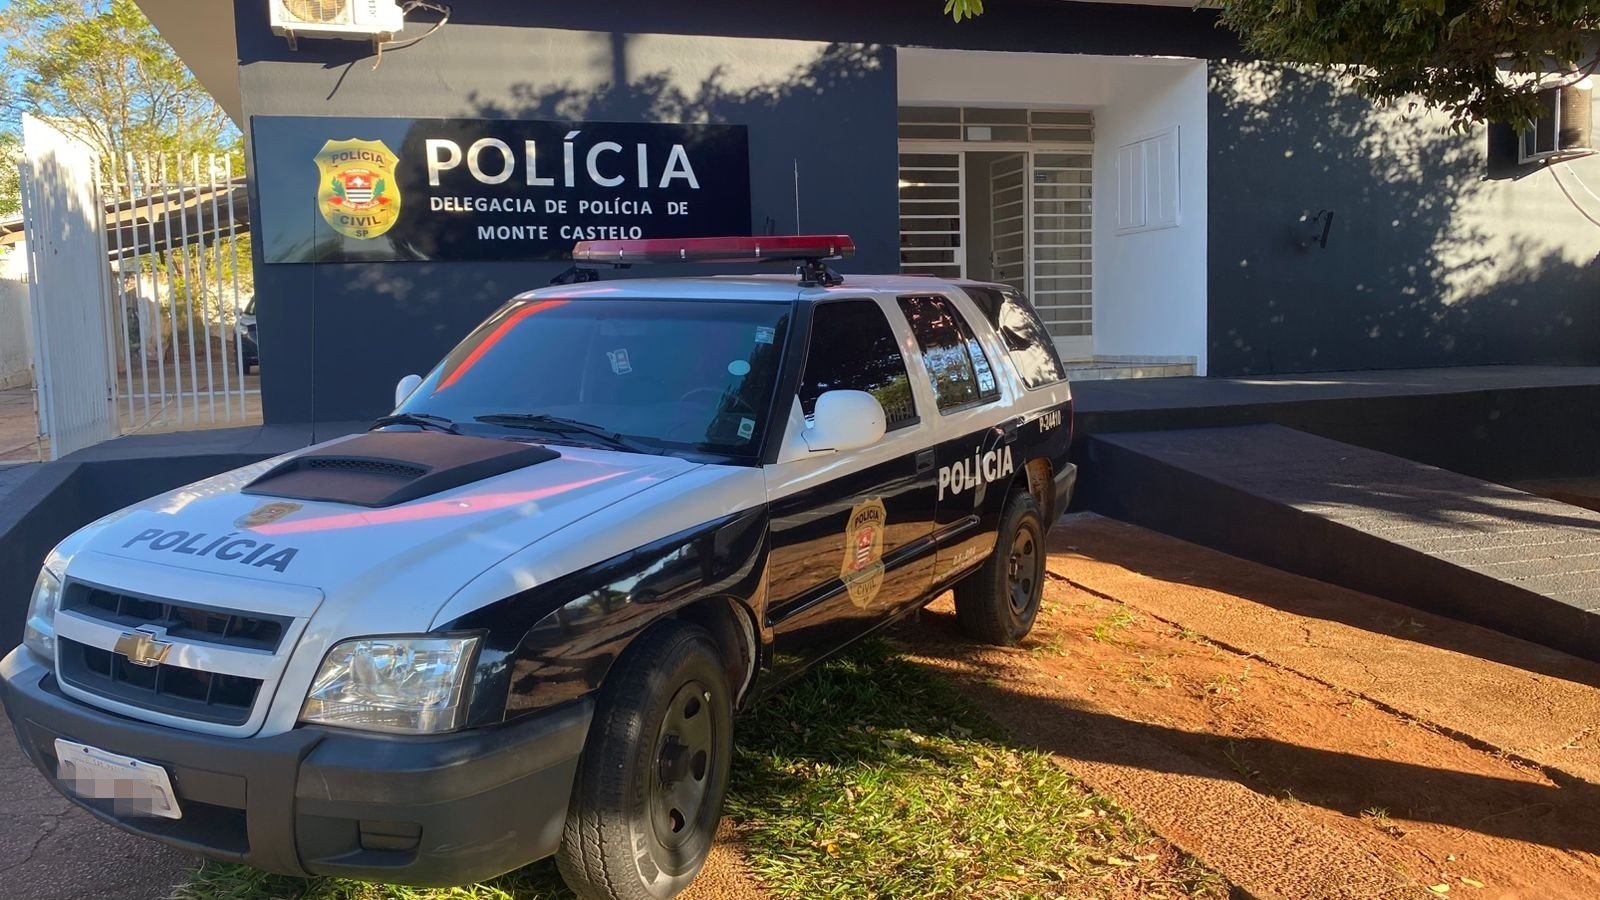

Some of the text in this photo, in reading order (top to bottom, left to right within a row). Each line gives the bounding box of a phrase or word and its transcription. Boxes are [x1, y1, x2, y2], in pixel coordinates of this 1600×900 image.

[426, 130, 700, 189] POLÍCIA
[430, 196, 688, 215] DELEGACIA DE POLÍCIA DE
[340, 215, 381, 226] CIVIL
[355, 229, 369, 237] SP
[478, 225, 642, 240] MONTE CASTELO
[938, 444, 1014, 502] POLÍCIA
[121, 528, 299, 573] POLÍCIA
[856, 579, 877, 596] CIVIL
